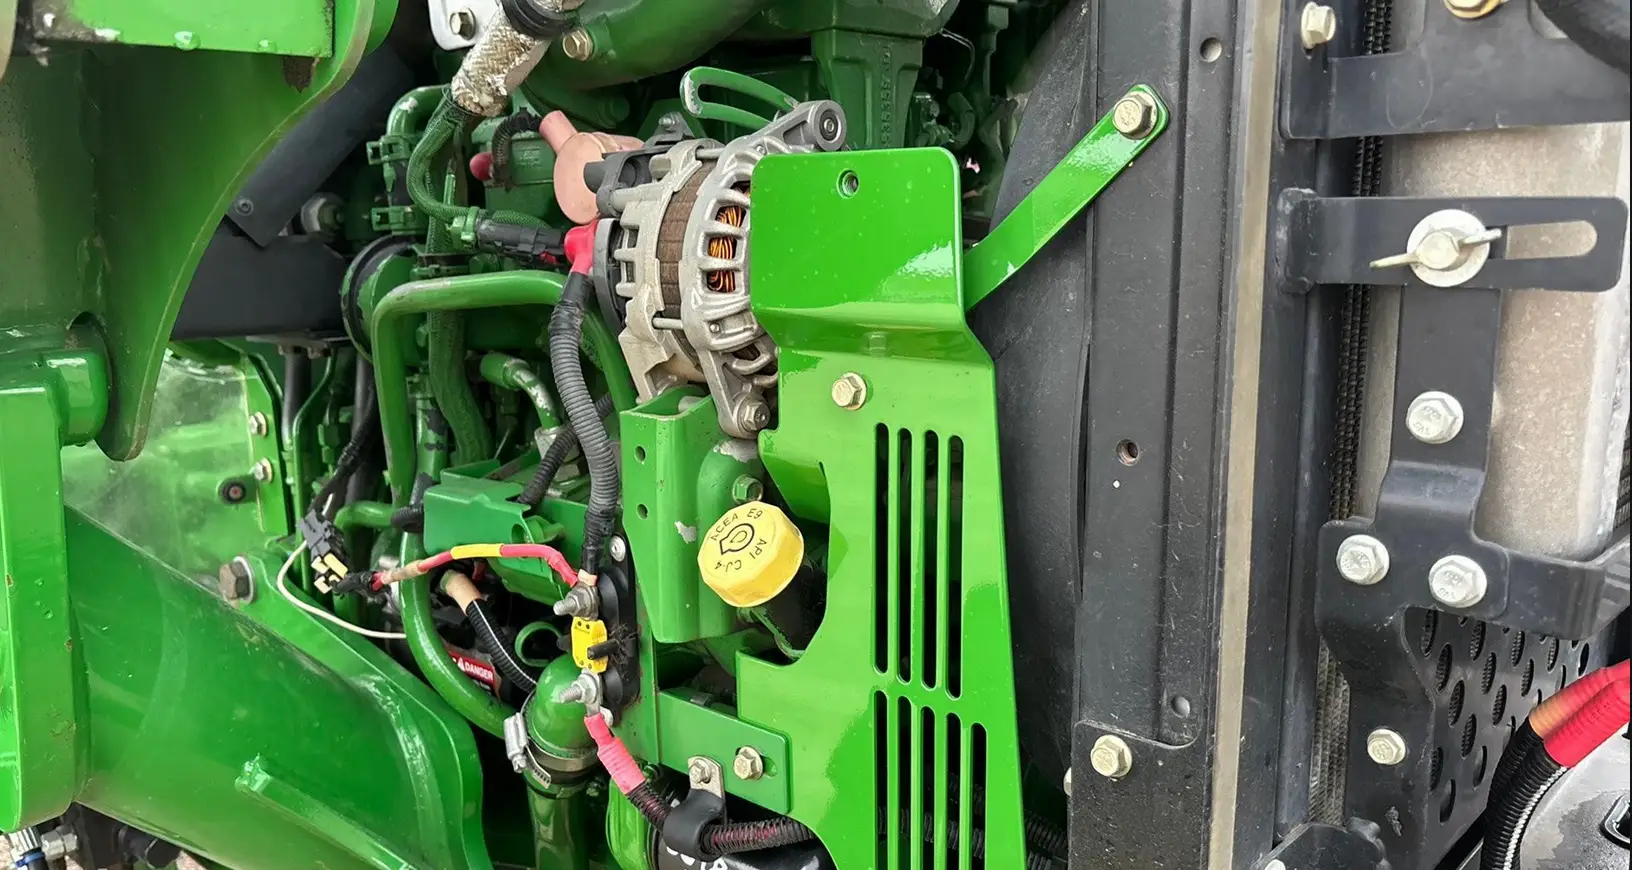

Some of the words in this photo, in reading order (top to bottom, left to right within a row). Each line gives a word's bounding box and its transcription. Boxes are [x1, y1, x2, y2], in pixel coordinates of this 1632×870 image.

[710, 513, 739, 541] ACEA
[746, 508, 763, 519] E9
[749, 538, 767, 559] API
[714, 559, 742, 572] CJ-4
[464, 660, 494, 681] DANGER
